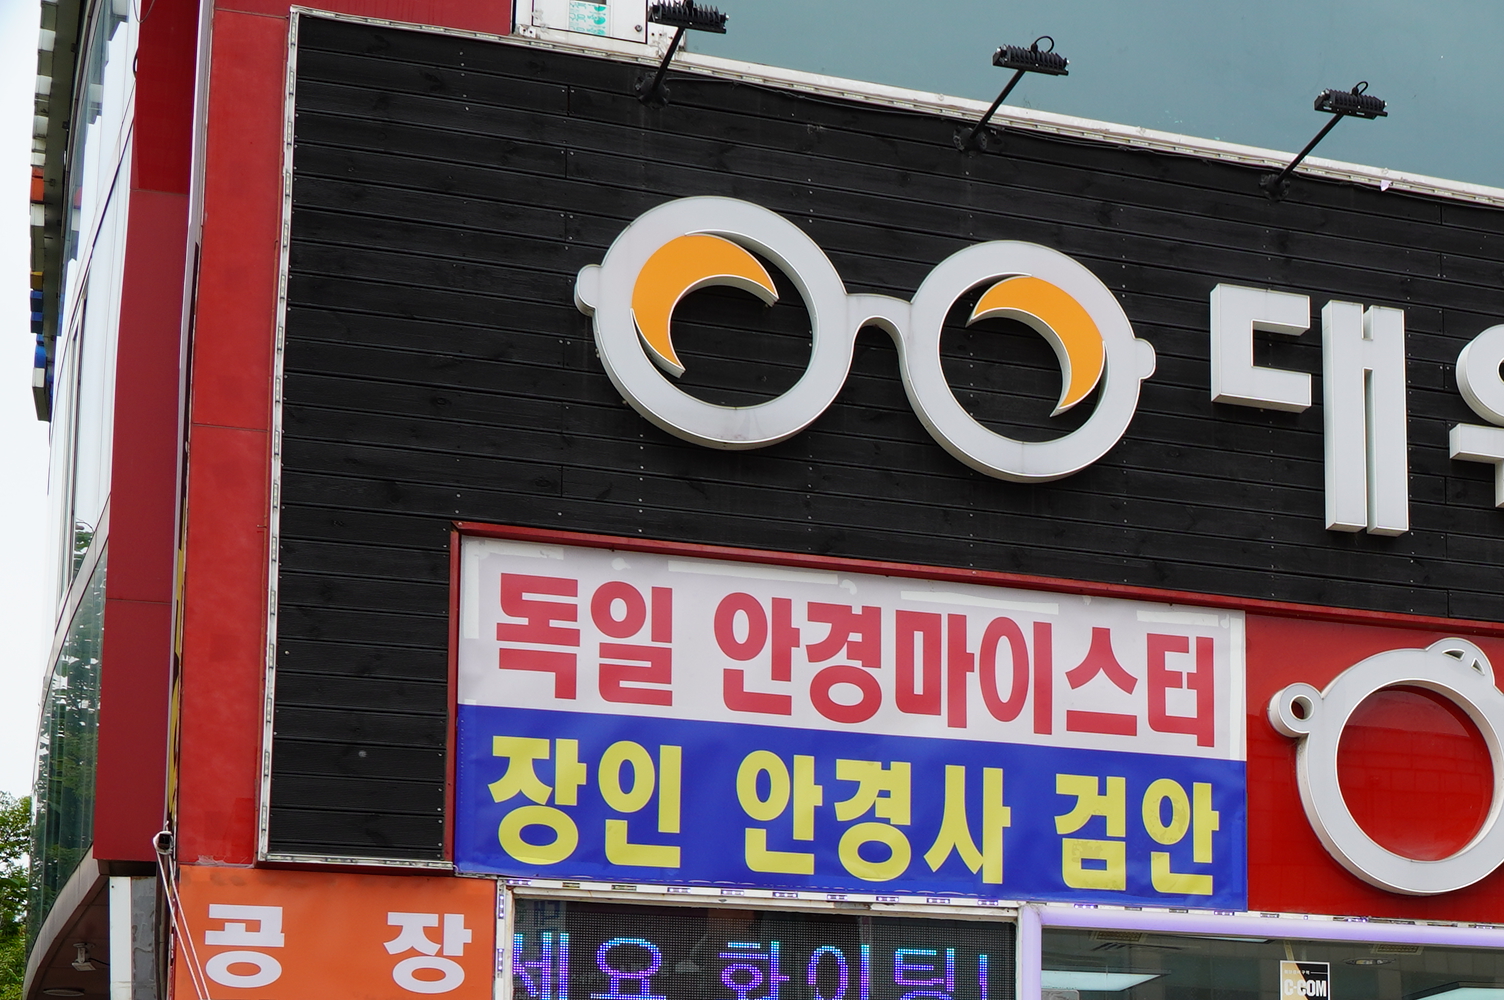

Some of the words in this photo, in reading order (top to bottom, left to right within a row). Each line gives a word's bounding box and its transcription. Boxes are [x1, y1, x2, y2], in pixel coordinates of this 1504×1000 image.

[496, 572, 673, 706] 독일
[713, 592, 1215, 747] 안경마이스터
[487, 736, 682, 869] 장인
[736, 750, 1010, 884] 안경사
[1054, 774, 1220, 896] 검안
